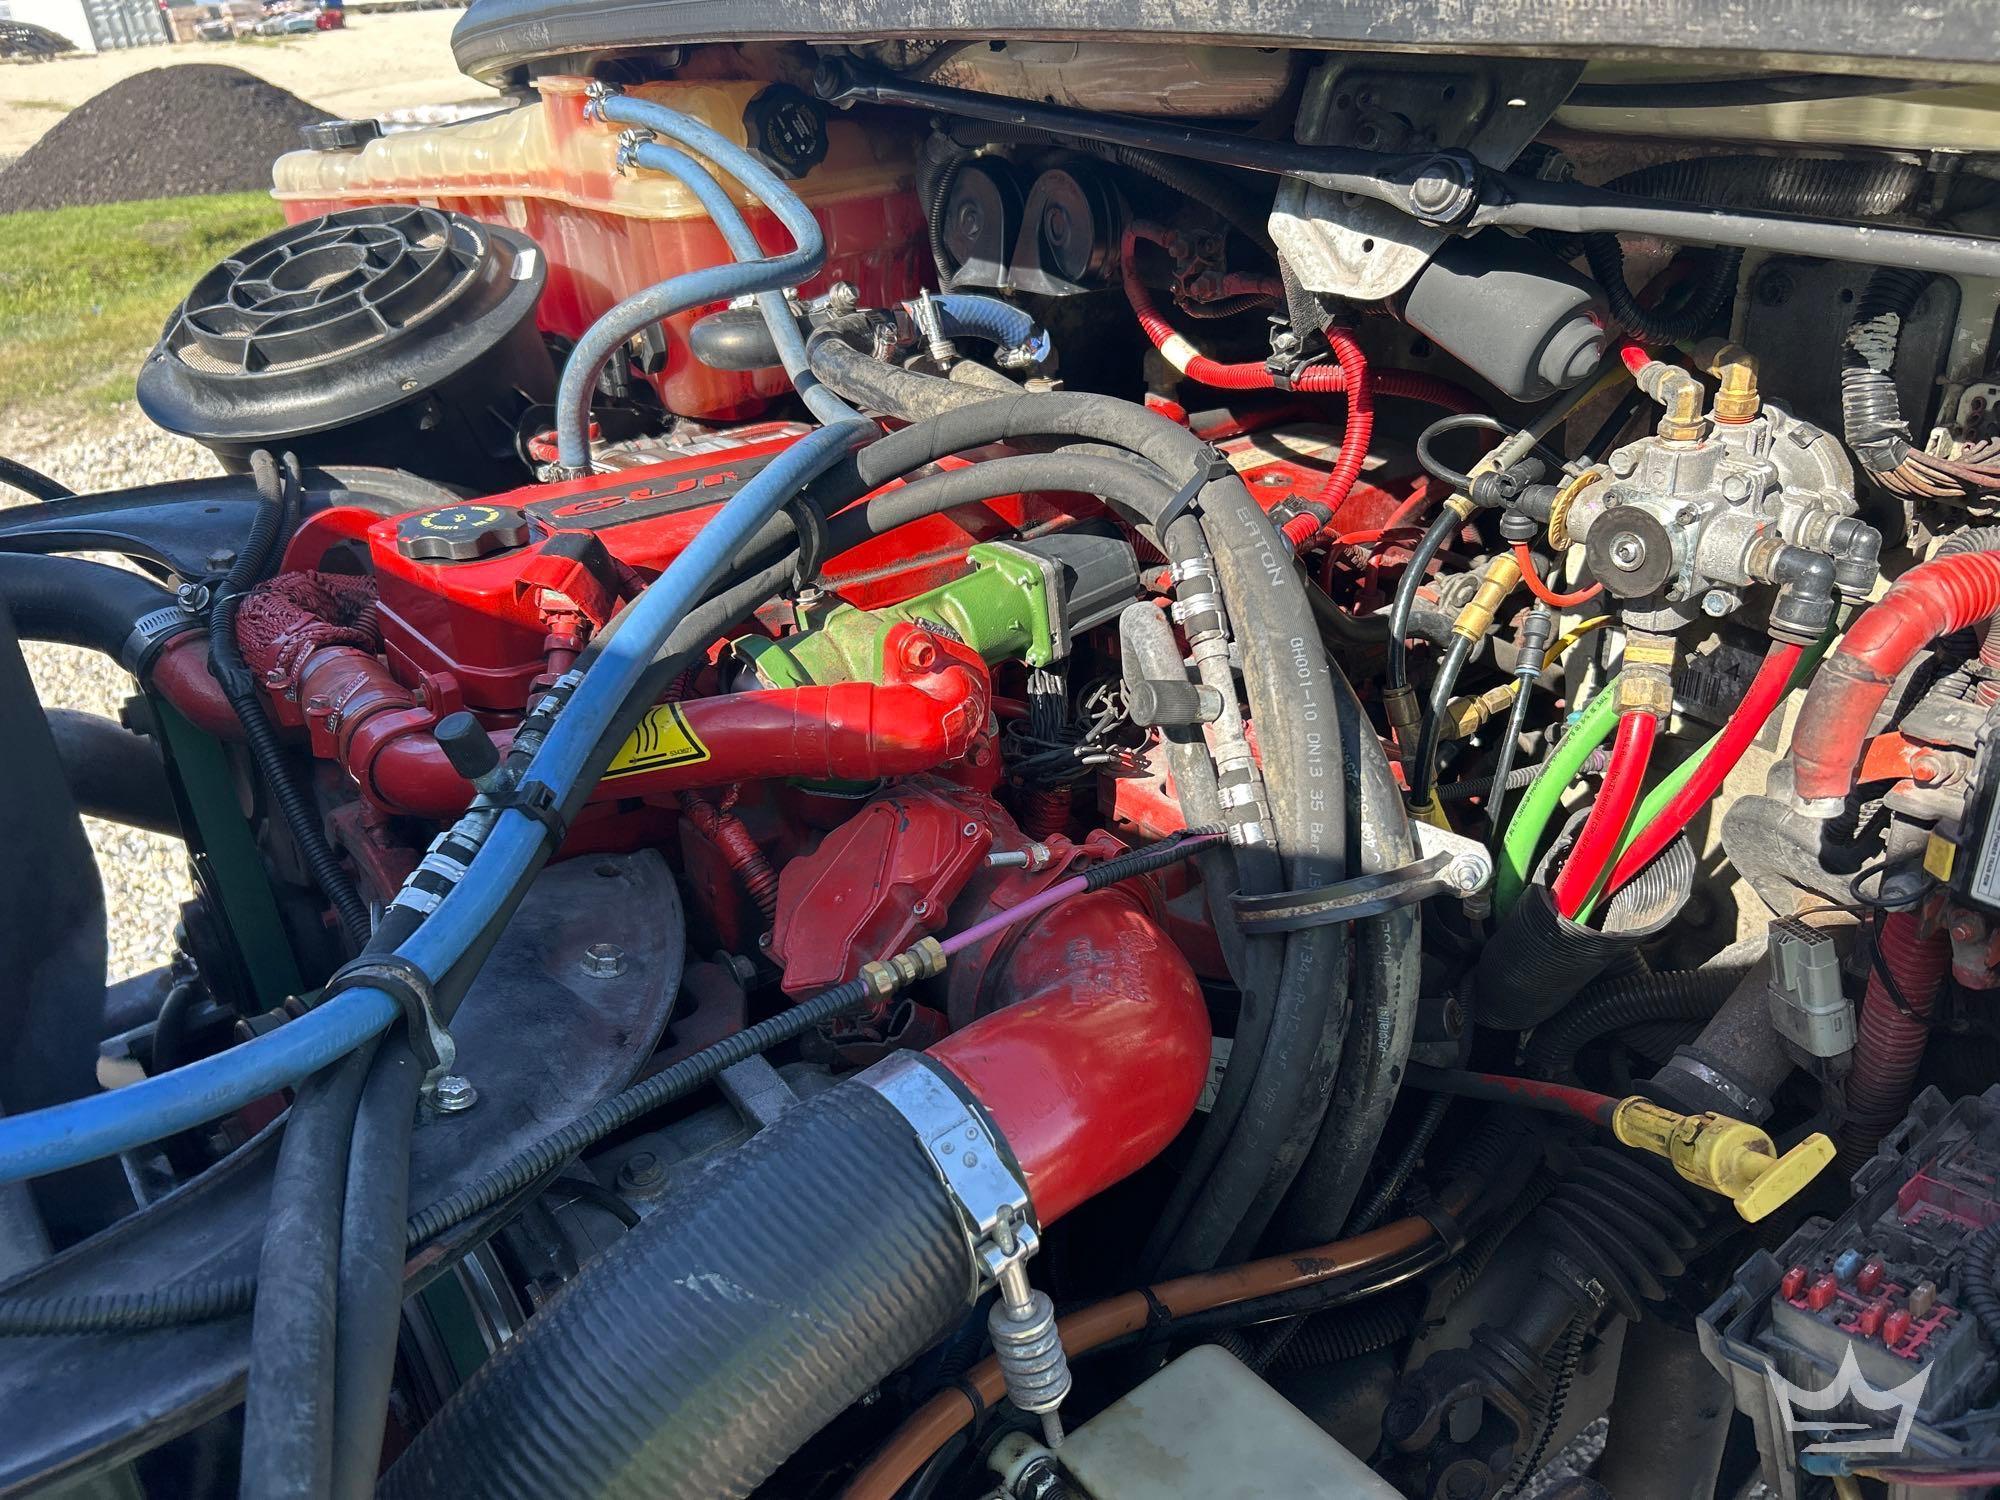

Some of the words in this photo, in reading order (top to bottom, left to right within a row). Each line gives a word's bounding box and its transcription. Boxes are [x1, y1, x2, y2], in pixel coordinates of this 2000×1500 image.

[1235, 506, 1285, 587] EATON
[1306, 733, 1323, 778] DN13
[1310, 789, 1324, 811] 35
[1310, 822, 1324, 854] Bar
